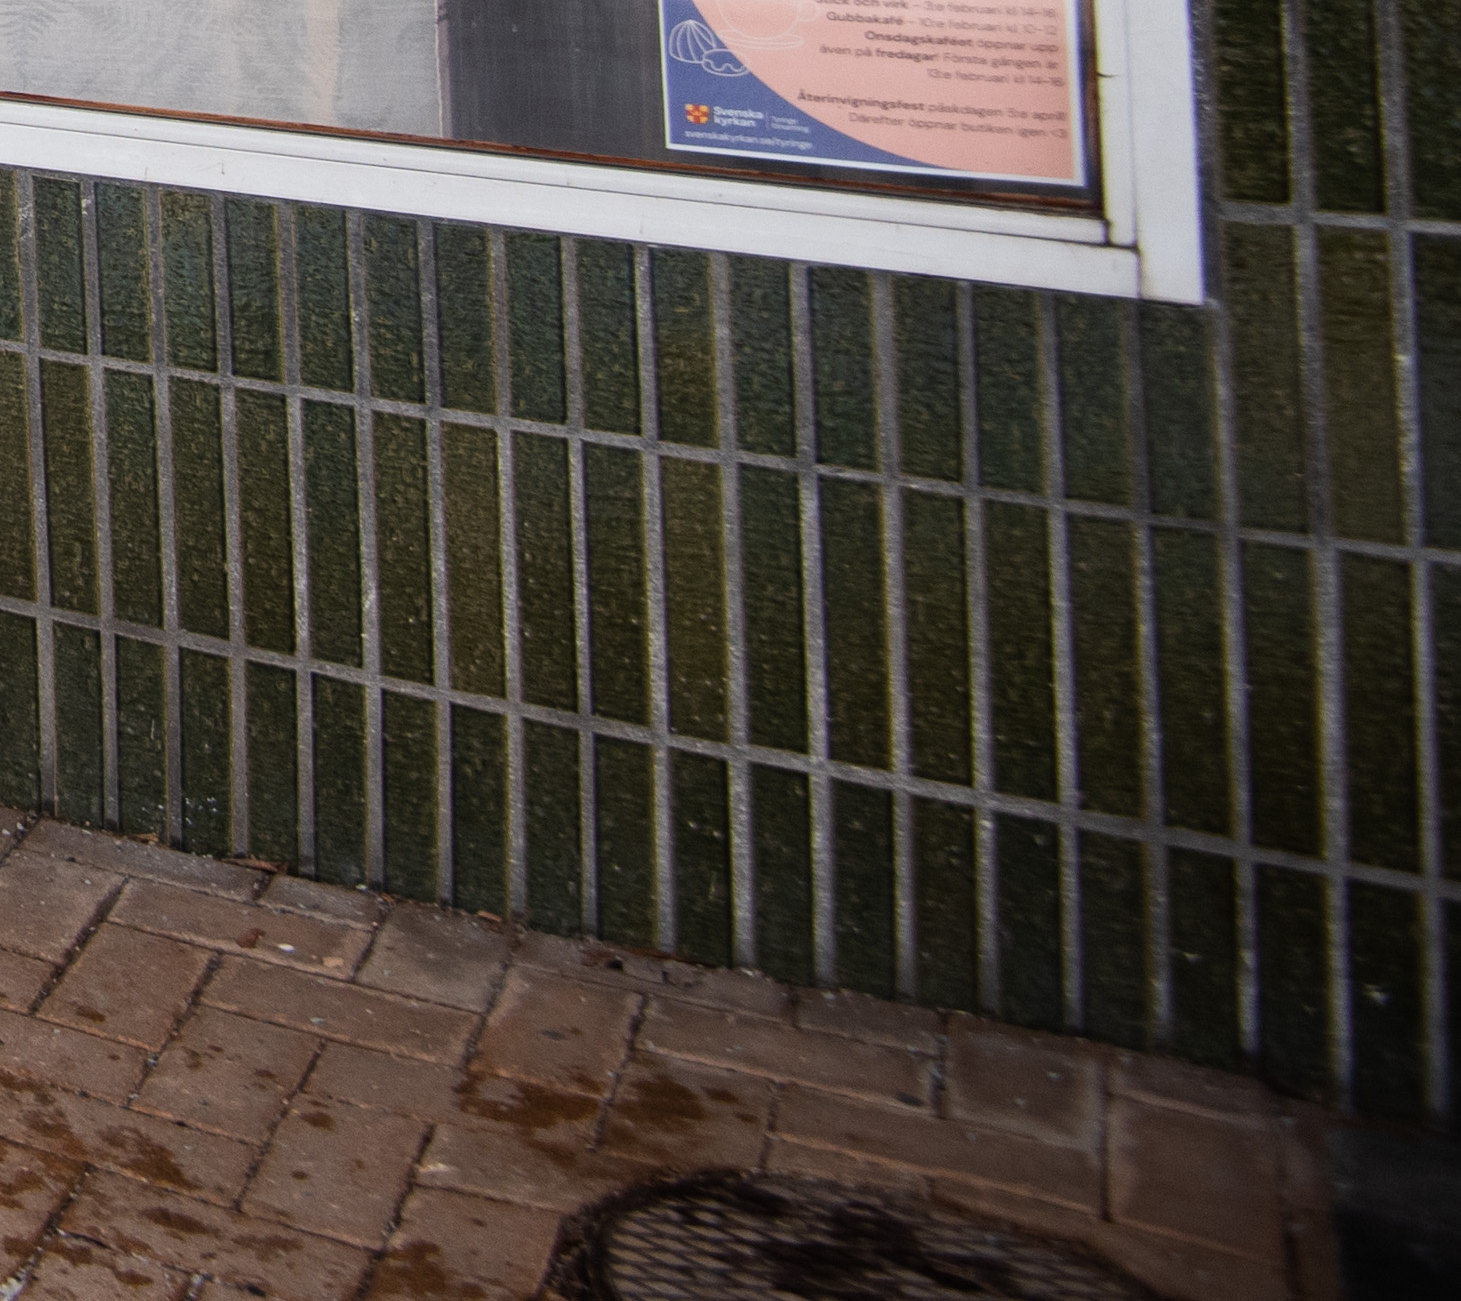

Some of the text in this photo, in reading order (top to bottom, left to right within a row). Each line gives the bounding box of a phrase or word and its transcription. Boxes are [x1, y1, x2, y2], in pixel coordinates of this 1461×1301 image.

[947, 1, 1003, 14] februari
[826, 10, 904, 26] Gubbakafé
[948, 18, 1002, 31] februari
[977, 38, 1025, 52] öppnar
[819, 45, 851, 55] även
[855, 46, 872, 59] på
[944, 52, 988, 65] Första
[991, 56, 1042, 70] gången
[956, 70, 1010, 83] februari
[797, 89, 924, 111] Återinvigningsfest
[928, 102, 1004, 118] påskdagen
[713, 106, 764, 118] Svenska
[713, 116, 756, 127] kyrkan
[848, 112, 904, 126] Därefter
[908, 116, 957, 131] öppnar
[961, 119, 1014, 135] butiken
